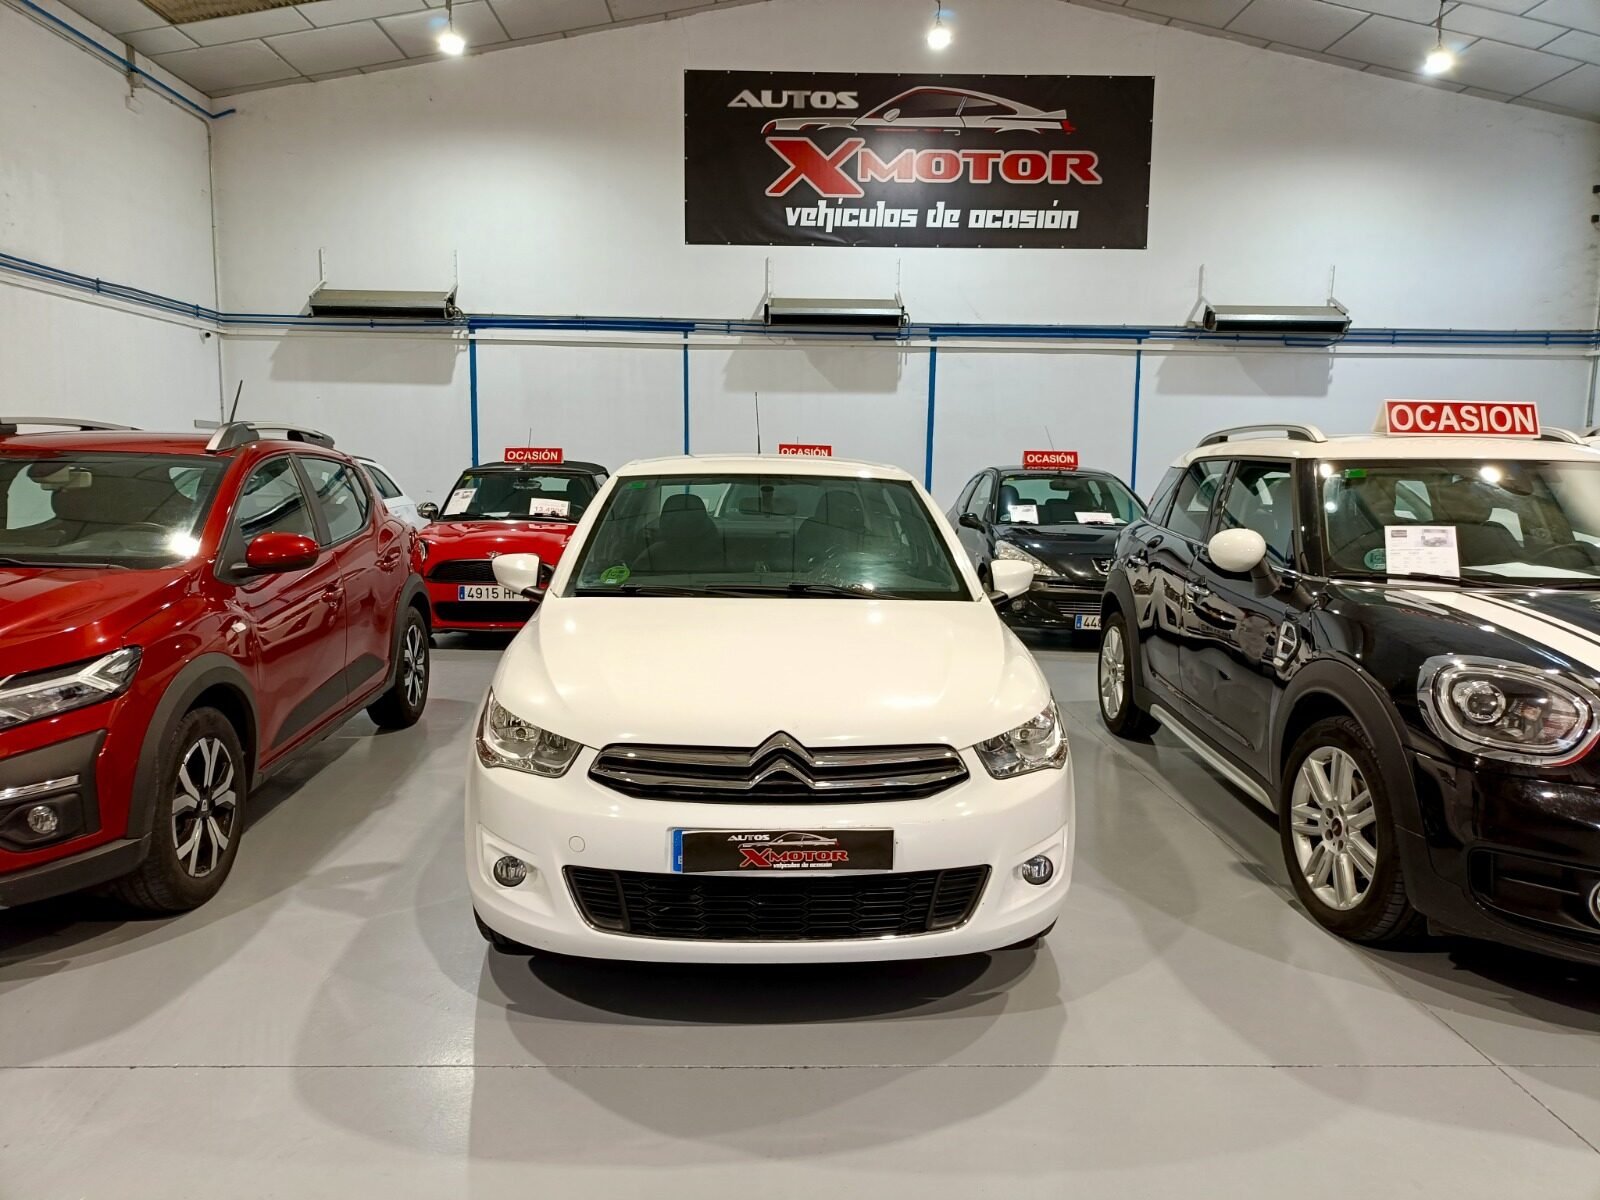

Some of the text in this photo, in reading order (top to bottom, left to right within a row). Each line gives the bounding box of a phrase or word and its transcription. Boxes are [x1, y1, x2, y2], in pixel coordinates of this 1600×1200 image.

[727, 89, 859, 109] AUTOS
[765, 136, 1103, 198] XMOTOR
[785, 198, 1079, 233] vehículos de ocasión
[1391, 404, 1535, 433] OCASION
[507, 449, 558, 461] OCASIÓN
[1027, 452, 1075, 463] OCASIÓN
[467, 587, 499, 599] 4915
[739, 848, 849, 867] XMOTOR
